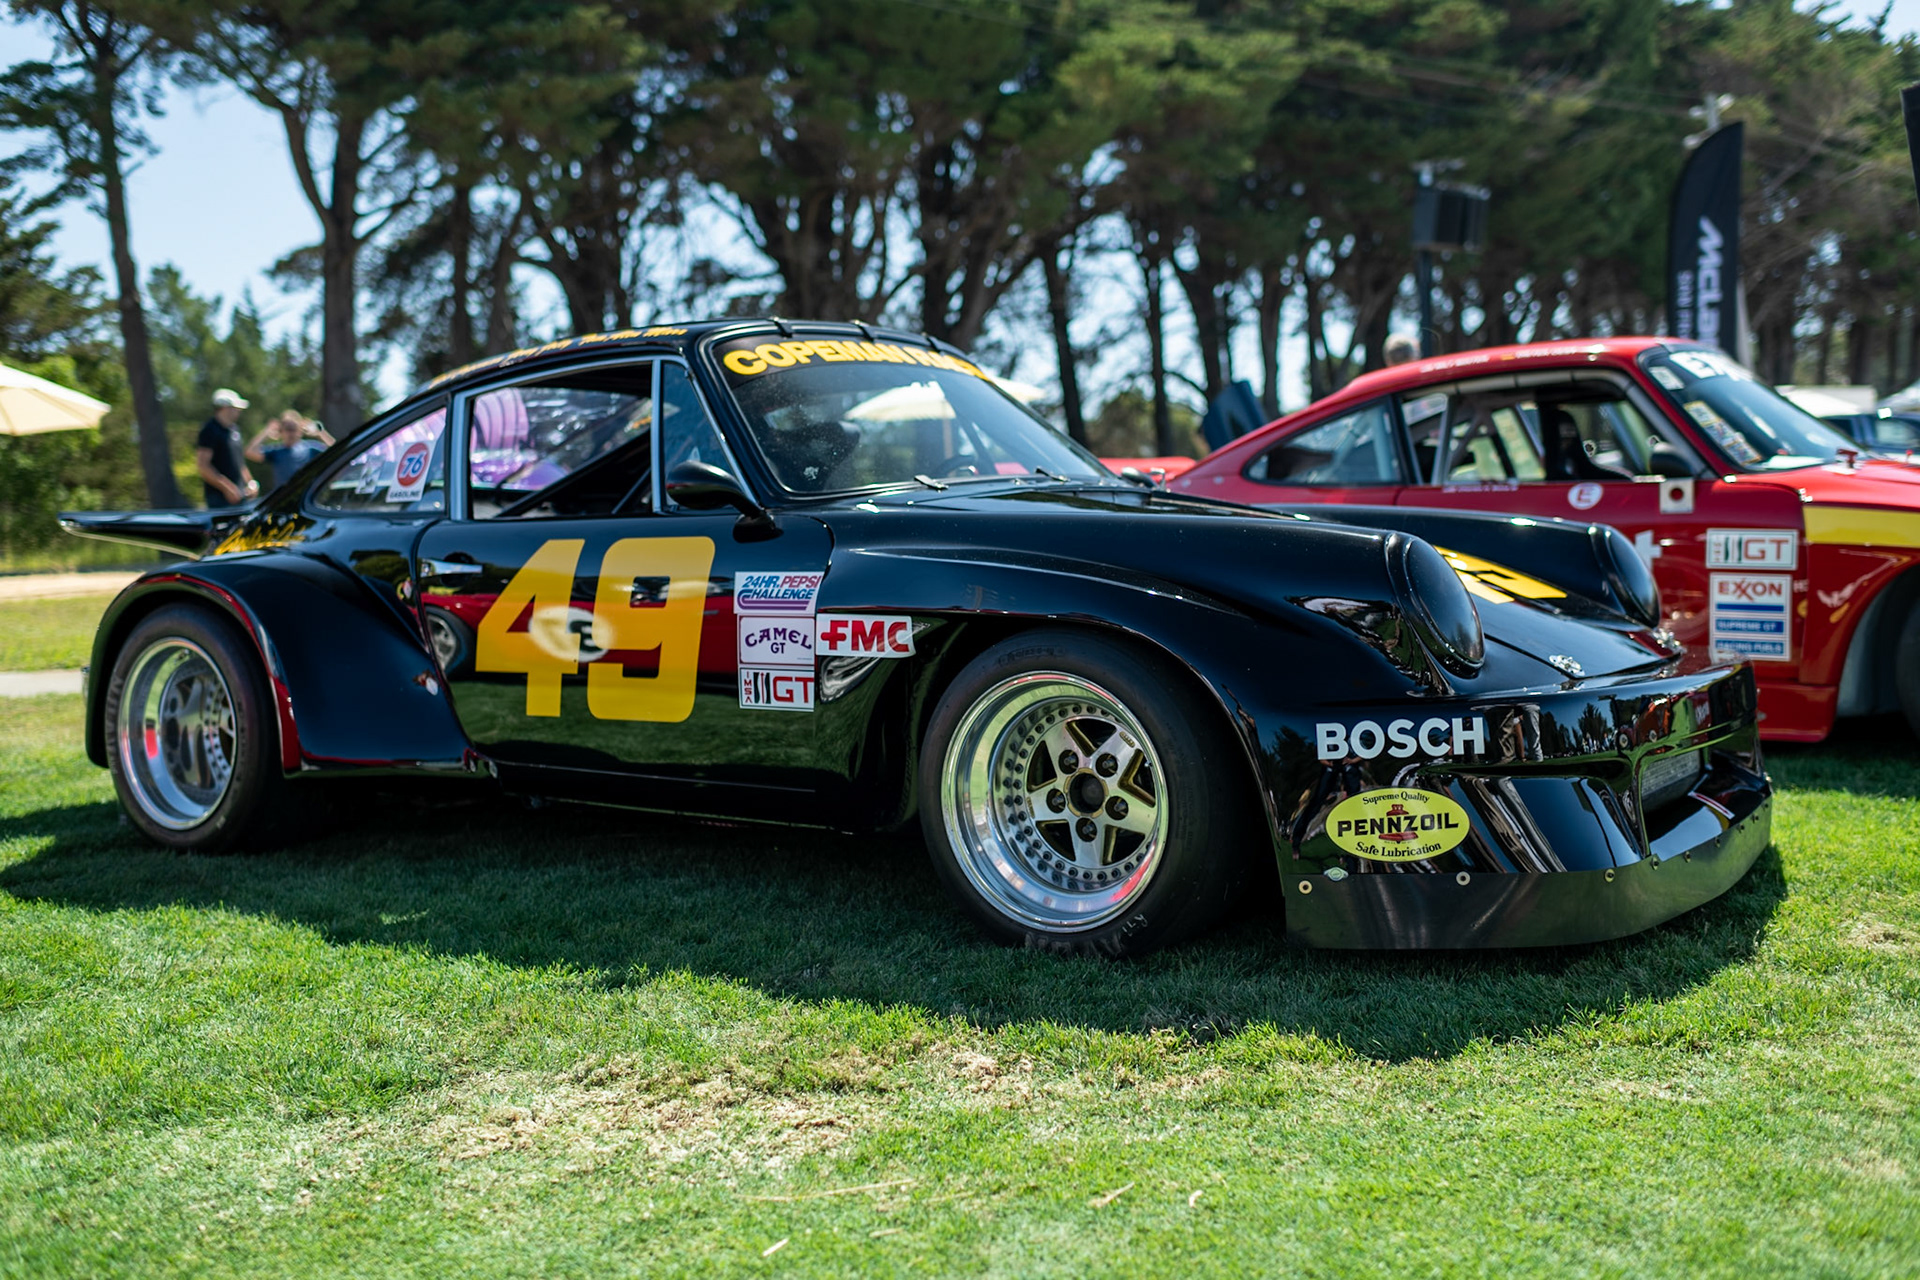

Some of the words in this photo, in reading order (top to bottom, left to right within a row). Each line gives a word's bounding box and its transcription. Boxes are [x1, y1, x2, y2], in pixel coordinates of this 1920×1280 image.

[723, 340, 917, 375] COPEMAN
[400, 450, 427, 478] 76
[1743, 538, 1789, 561] GT
[780, 575, 821, 588] PEPSI
[1717, 578, 1783, 602] EXXON
[738, 588, 815, 603] CHALLENGE
[475, 536, 716, 723] 49
[745, 627, 812, 650] CAMEL
[820, 619, 910, 653] FMC
[770, 642, 786, 654] GT
[773, 676, 815, 703] GT
[1316, 717, 1485, 760] BOSCH
[1362, 794, 1400, 806] Supreme
[1400, 791, 1431, 804] Quality
[1337, 812, 1459, 837] PENNZOIL
[1355, 841, 1380, 856] Safe
[1381, 842, 1442, 858] Lubrication
